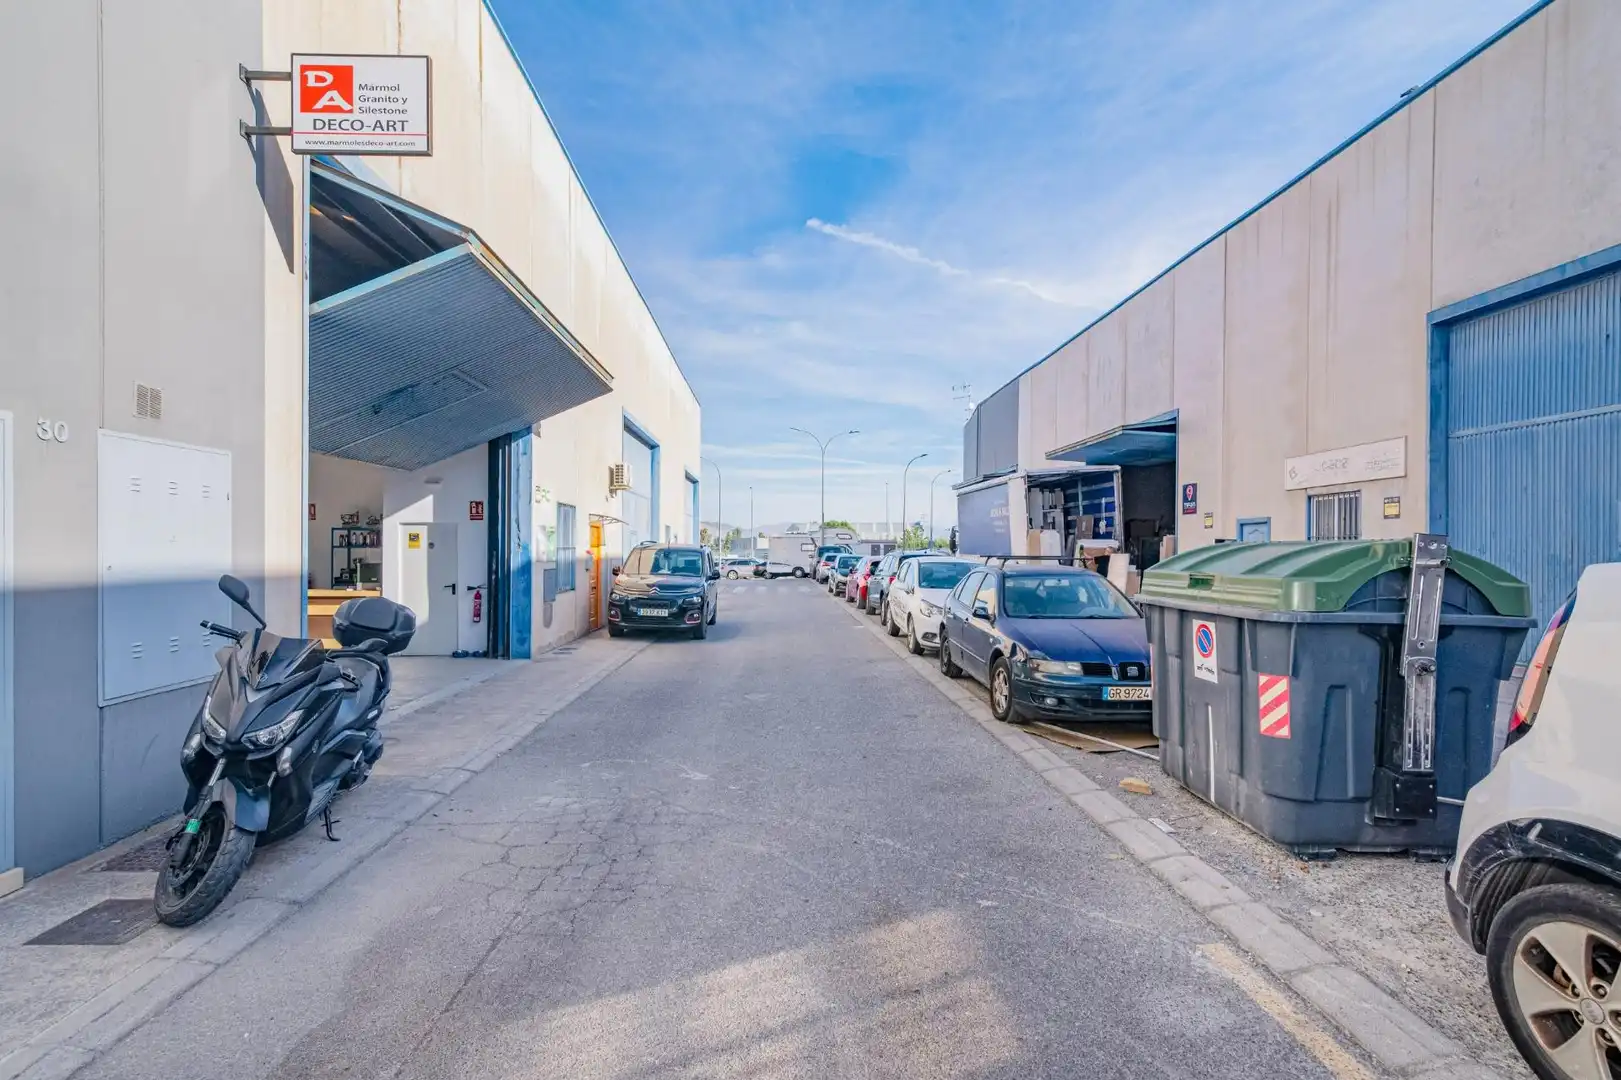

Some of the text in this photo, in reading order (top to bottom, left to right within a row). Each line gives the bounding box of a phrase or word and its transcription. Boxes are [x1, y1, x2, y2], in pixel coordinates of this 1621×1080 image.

[358, 94, 408, 105] Granito y
[358, 106, 408, 115] Silestone
[313, 118, 409, 132] DECO-ART
[304, 138, 416, 147] www.marmolesdeco-art.com
[1108, 687, 1150, 699] GR 9724
